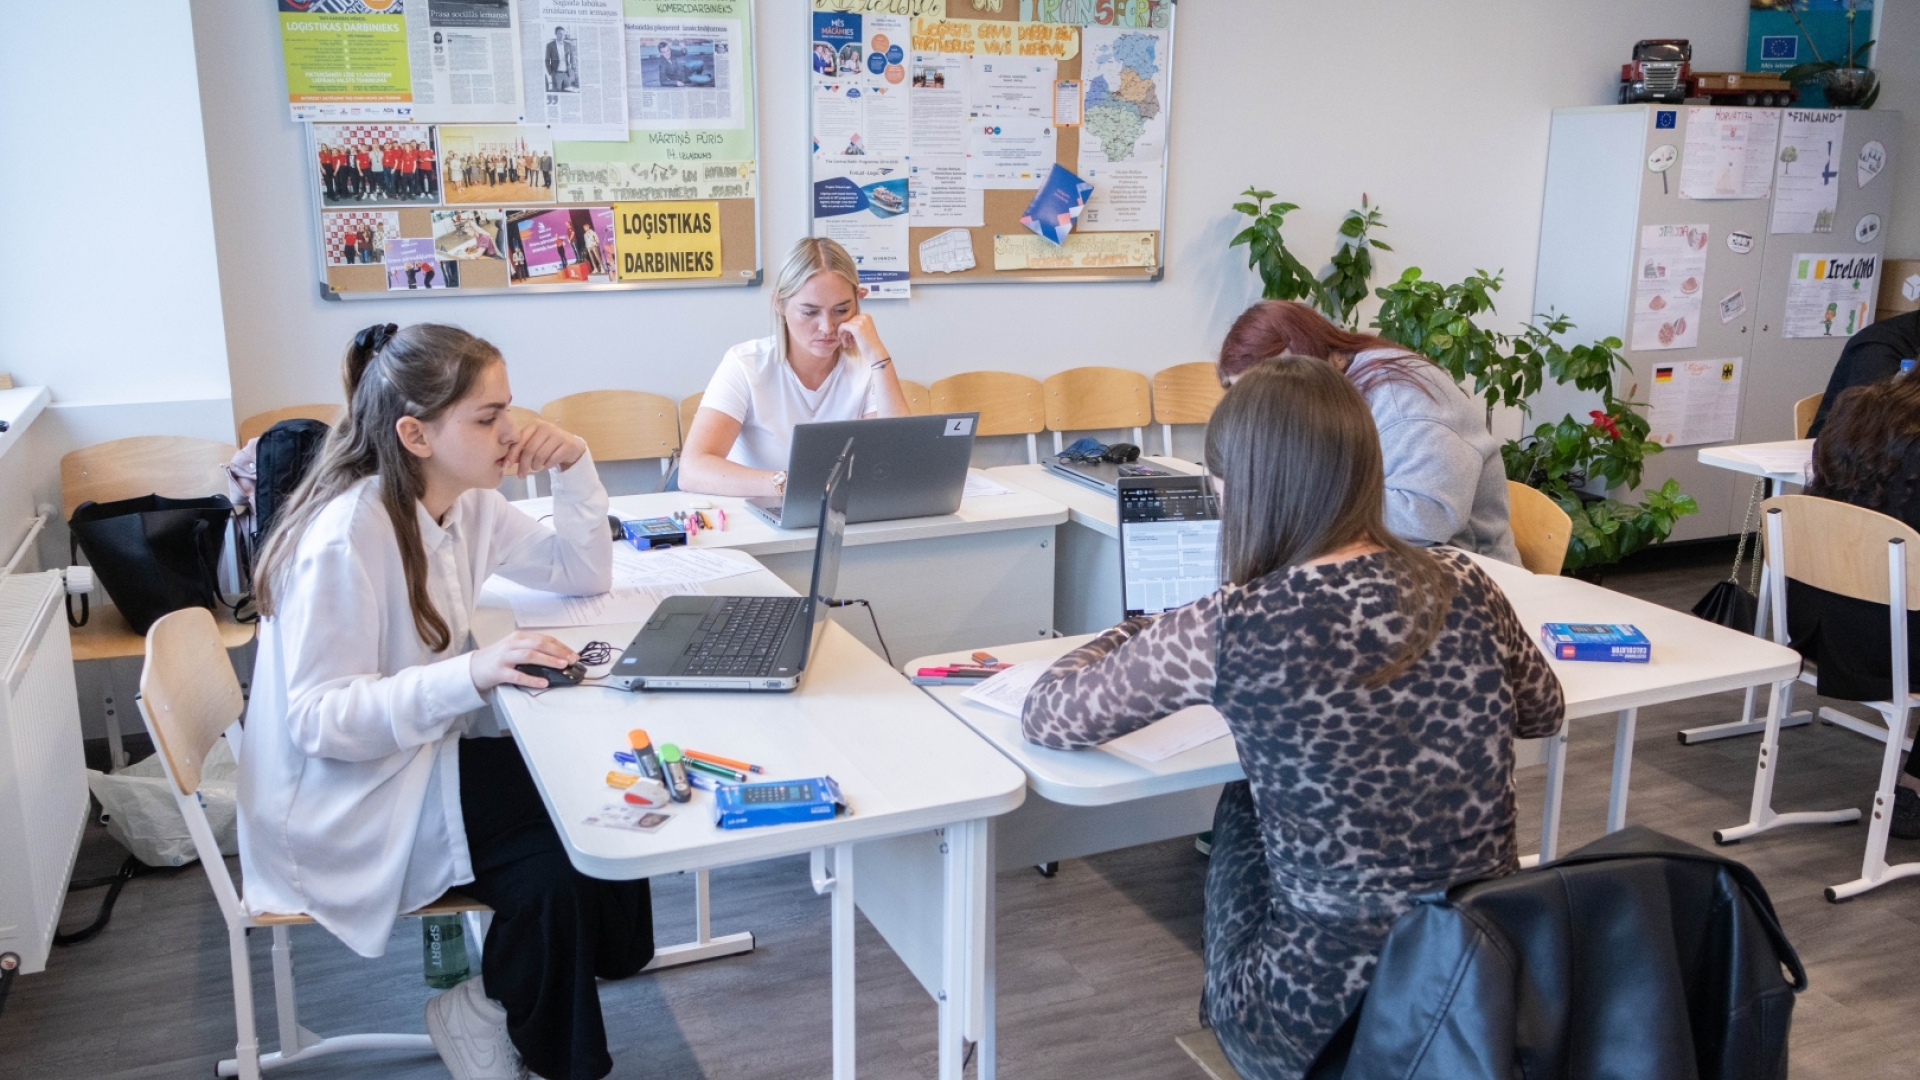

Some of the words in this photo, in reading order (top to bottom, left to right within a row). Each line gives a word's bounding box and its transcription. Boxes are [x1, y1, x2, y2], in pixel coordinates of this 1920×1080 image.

[286, 21, 342, 33] LOĢISTIKAS
[343, 21, 400, 33] DARBINIEKS
[1793, 111, 1836, 123] FINLAND
[649, 132, 691, 145] MĀRTIŅŠ
[696, 133, 723, 144] PŪRIS
[682, 169, 698, 183] UN
[622, 212, 712, 239] LOĢISTIKAS
[625, 251, 714, 273] DARBINIEKS
[1611, 646, 1647, 654] CALCULATOR
[430, 925, 442, 966] SPORT
